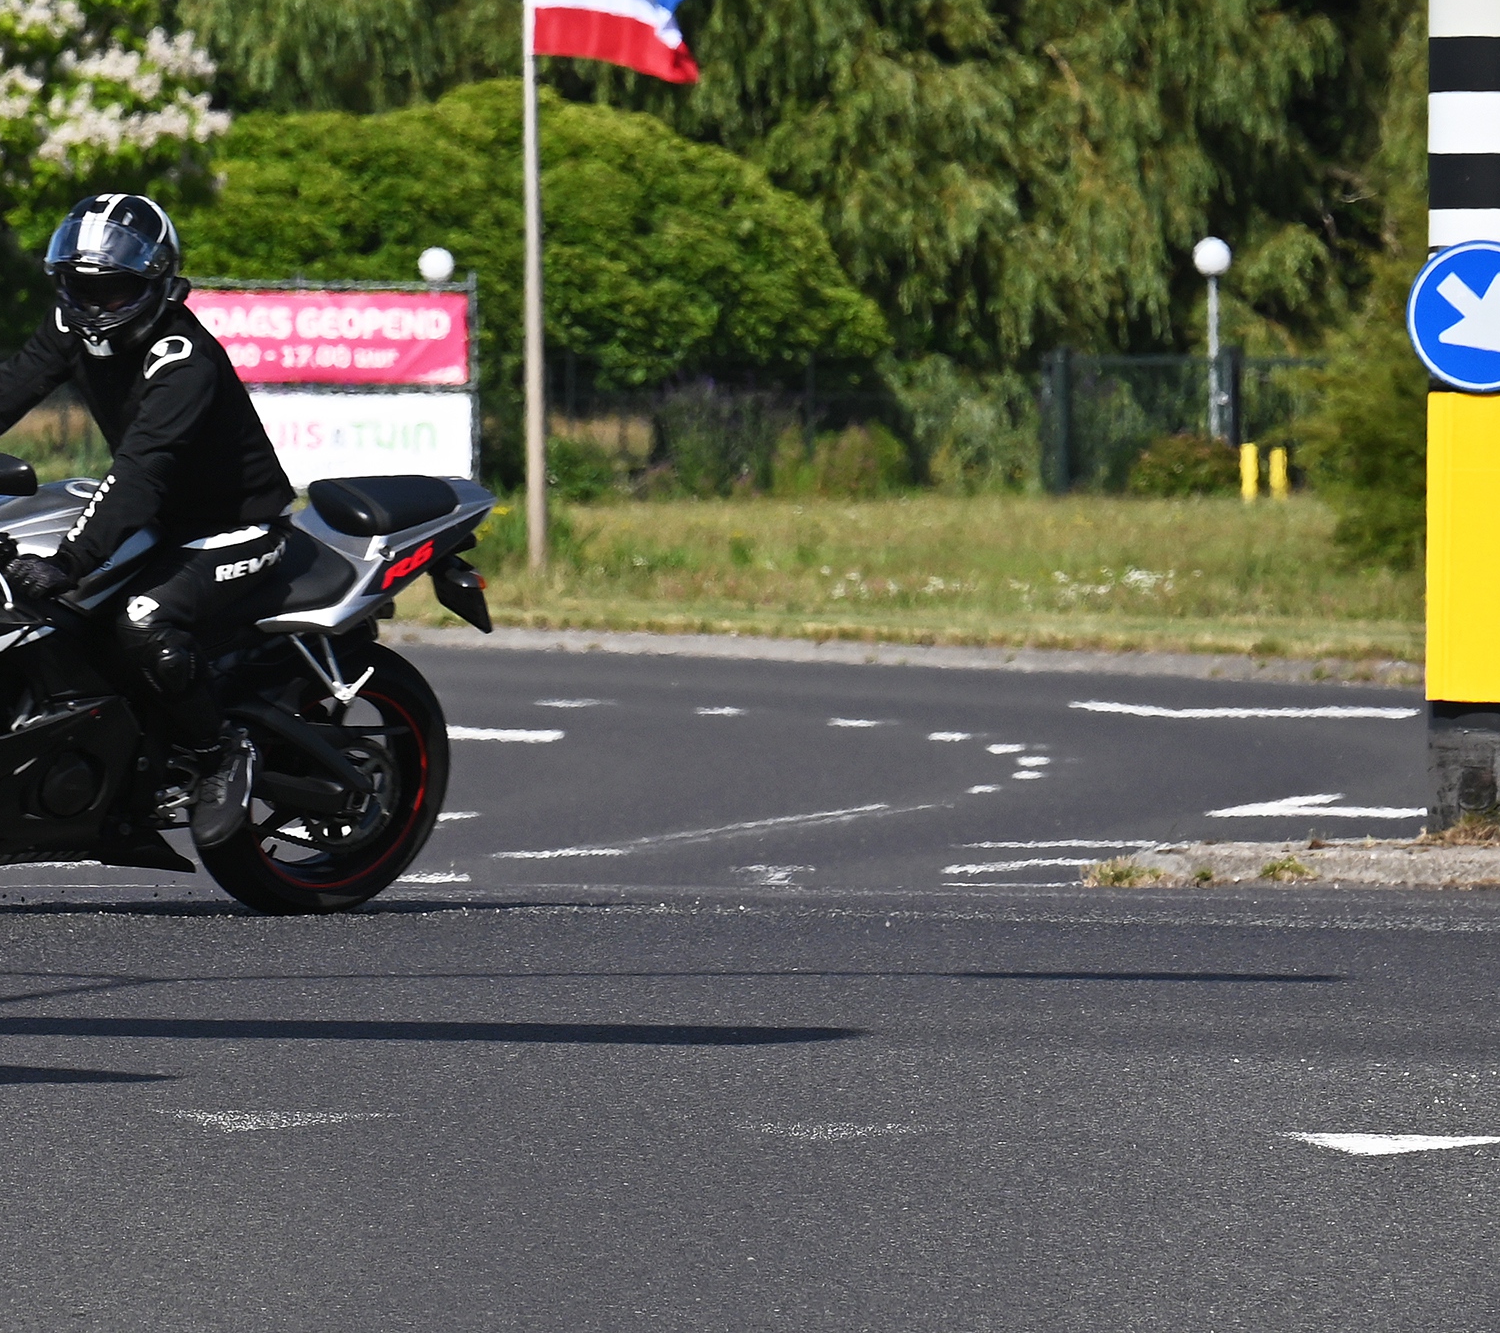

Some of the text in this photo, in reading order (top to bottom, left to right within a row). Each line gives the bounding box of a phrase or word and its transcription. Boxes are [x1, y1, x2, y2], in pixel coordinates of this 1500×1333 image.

[196, 305, 451, 340] DAGS GEOPEND
[226, 342, 262, 368] 00
[265, 419, 324, 450] UIS
[381, 539, 435, 590] R6
